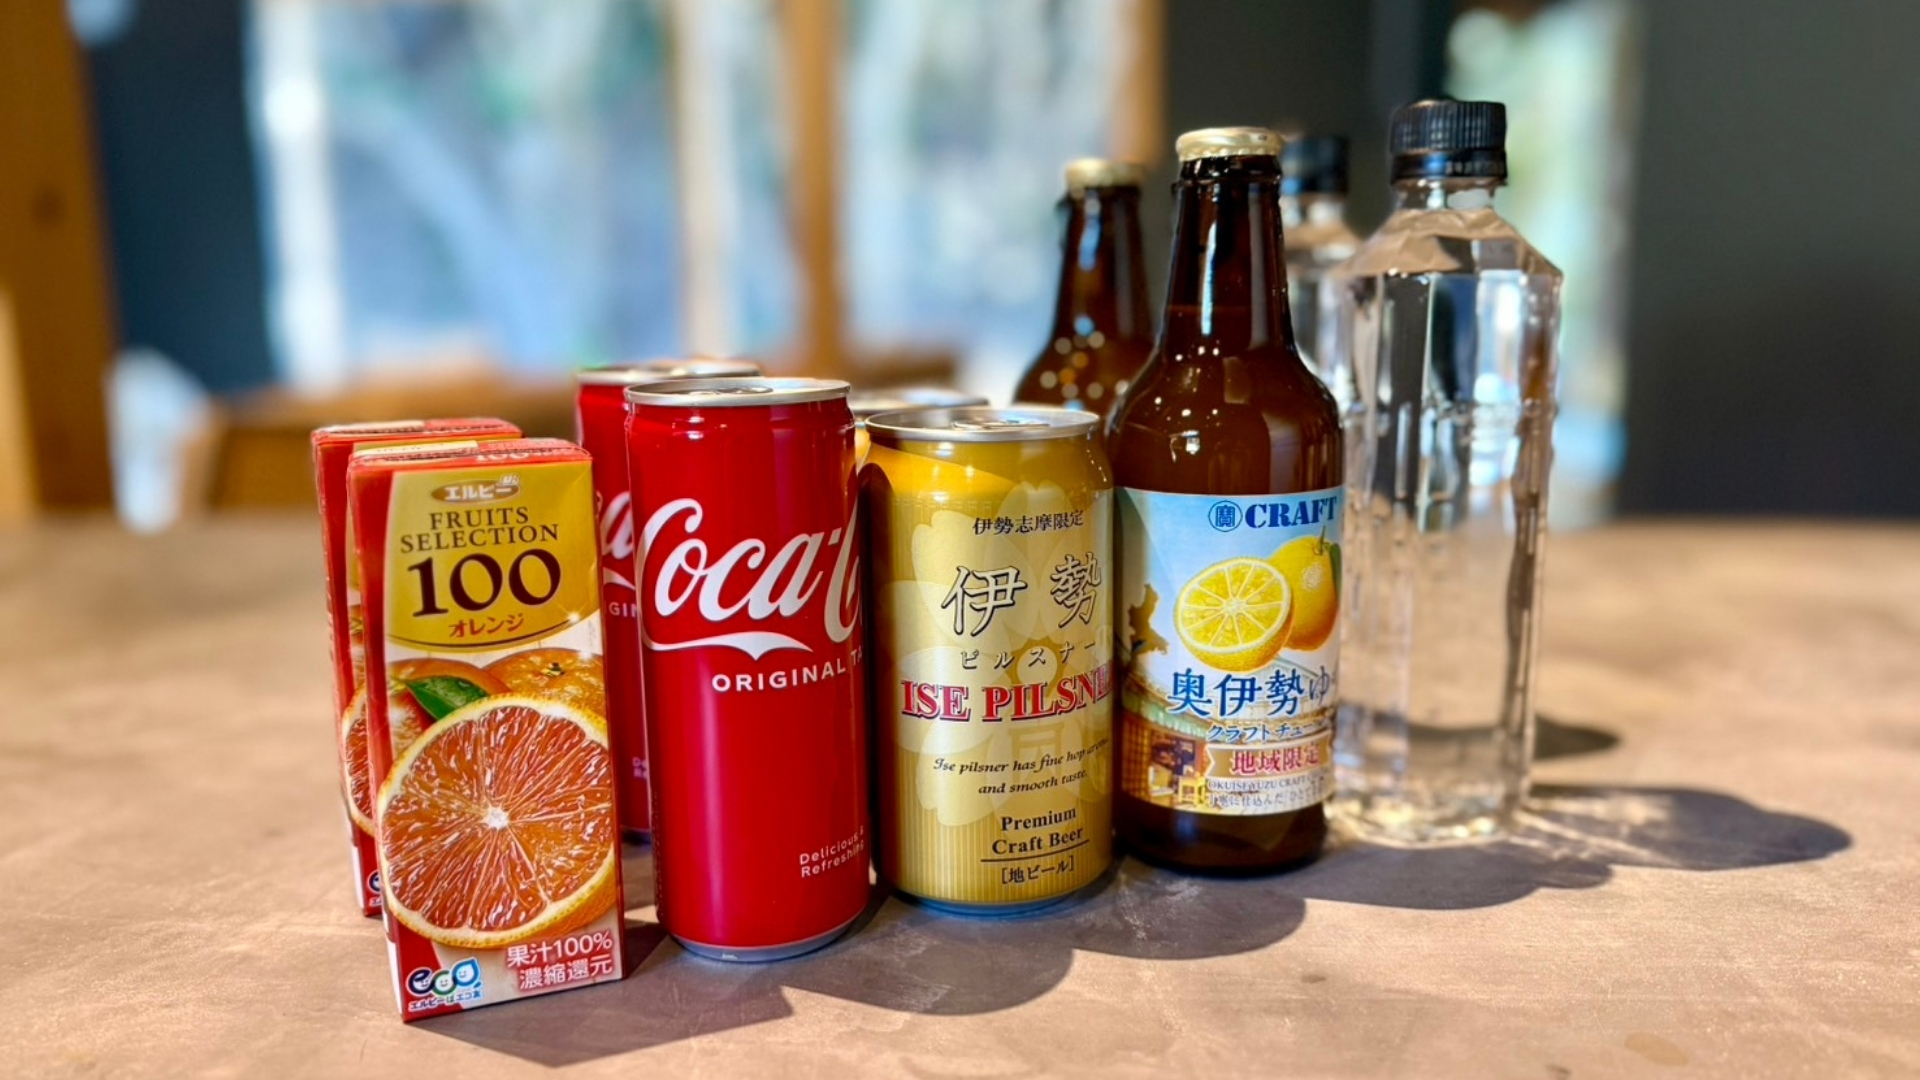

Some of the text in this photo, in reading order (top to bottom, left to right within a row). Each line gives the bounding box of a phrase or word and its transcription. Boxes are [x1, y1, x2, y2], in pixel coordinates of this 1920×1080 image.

[445, 483, 512, 501] エルビー
[429, 506, 529, 531] FRUITS
[972, 510, 1084, 536] 伊勢志摩限定
[1245, 496, 1338, 529] CRAFT
[400, 523, 559, 553] SELECTION
[408, 548, 561, 617] 100
[941, 552, 1102, 637] 伊勢
[448, 613, 525, 638] オレンジ
[961, 640, 1097, 670] ピルスナー
[711, 657, 847, 693] ORIGINAL
[901, 679, 970, 721] ISE
[1208, 723, 1271, 741] クラフト
[933, 757, 956, 772] Ise
[959, 758, 1009, 775] pilsner
[1013, 758, 1036, 773] has
[1034, 753, 1065, 773] fine
[1230, 742, 1320, 775] 地域限定
[978, 782, 1006, 795] and
[1009, 776, 1059, 793] smooth
[1000, 807, 1077, 832] Premium
[800, 832, 859, 866] Delicious
[991, 827, 1084, 856] Craft Beer
[506, 931, 613, 968] 果汁100%
[519, 956, 613, 991] 濃縮還元
